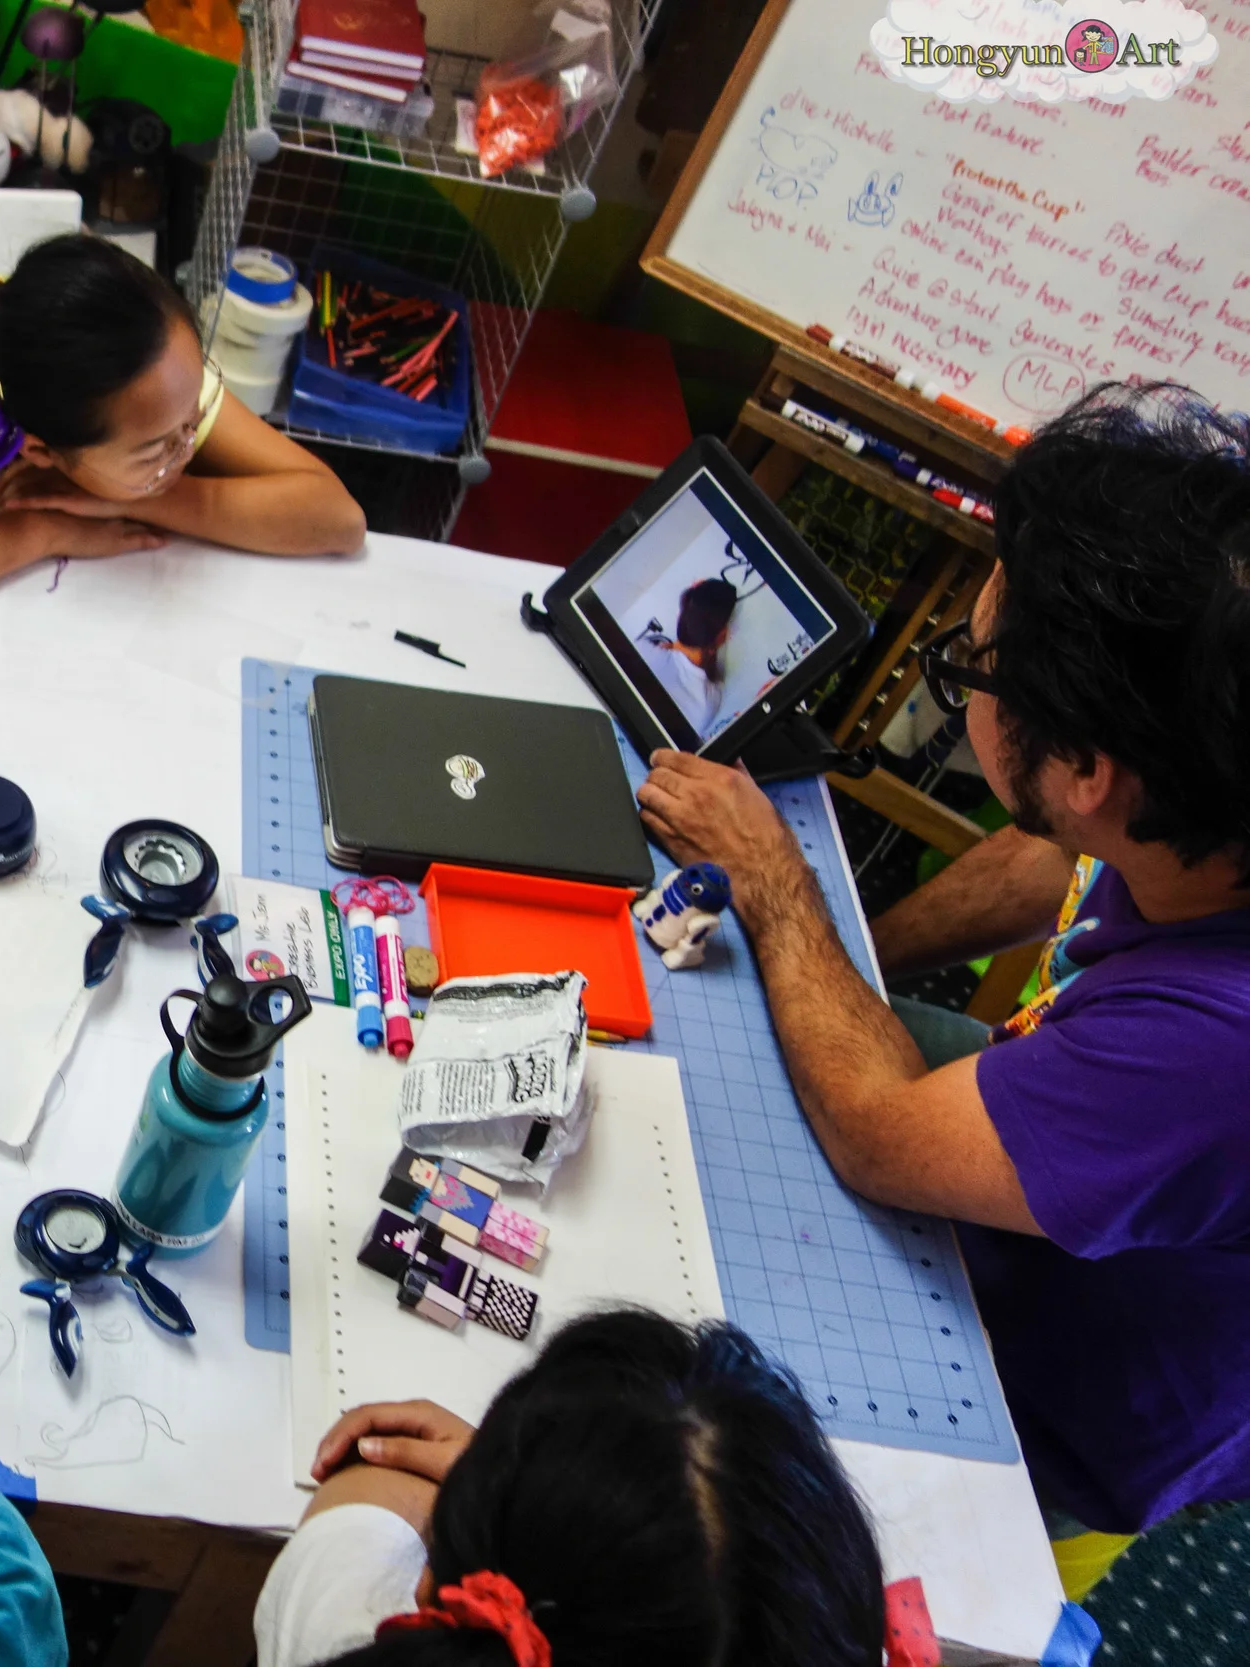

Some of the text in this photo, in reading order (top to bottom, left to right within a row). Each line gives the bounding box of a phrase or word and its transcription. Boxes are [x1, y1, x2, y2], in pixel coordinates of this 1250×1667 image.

[1018, 359, 1082, 400] MLP
[326, 910, 347, 981] EXPO ONLY
